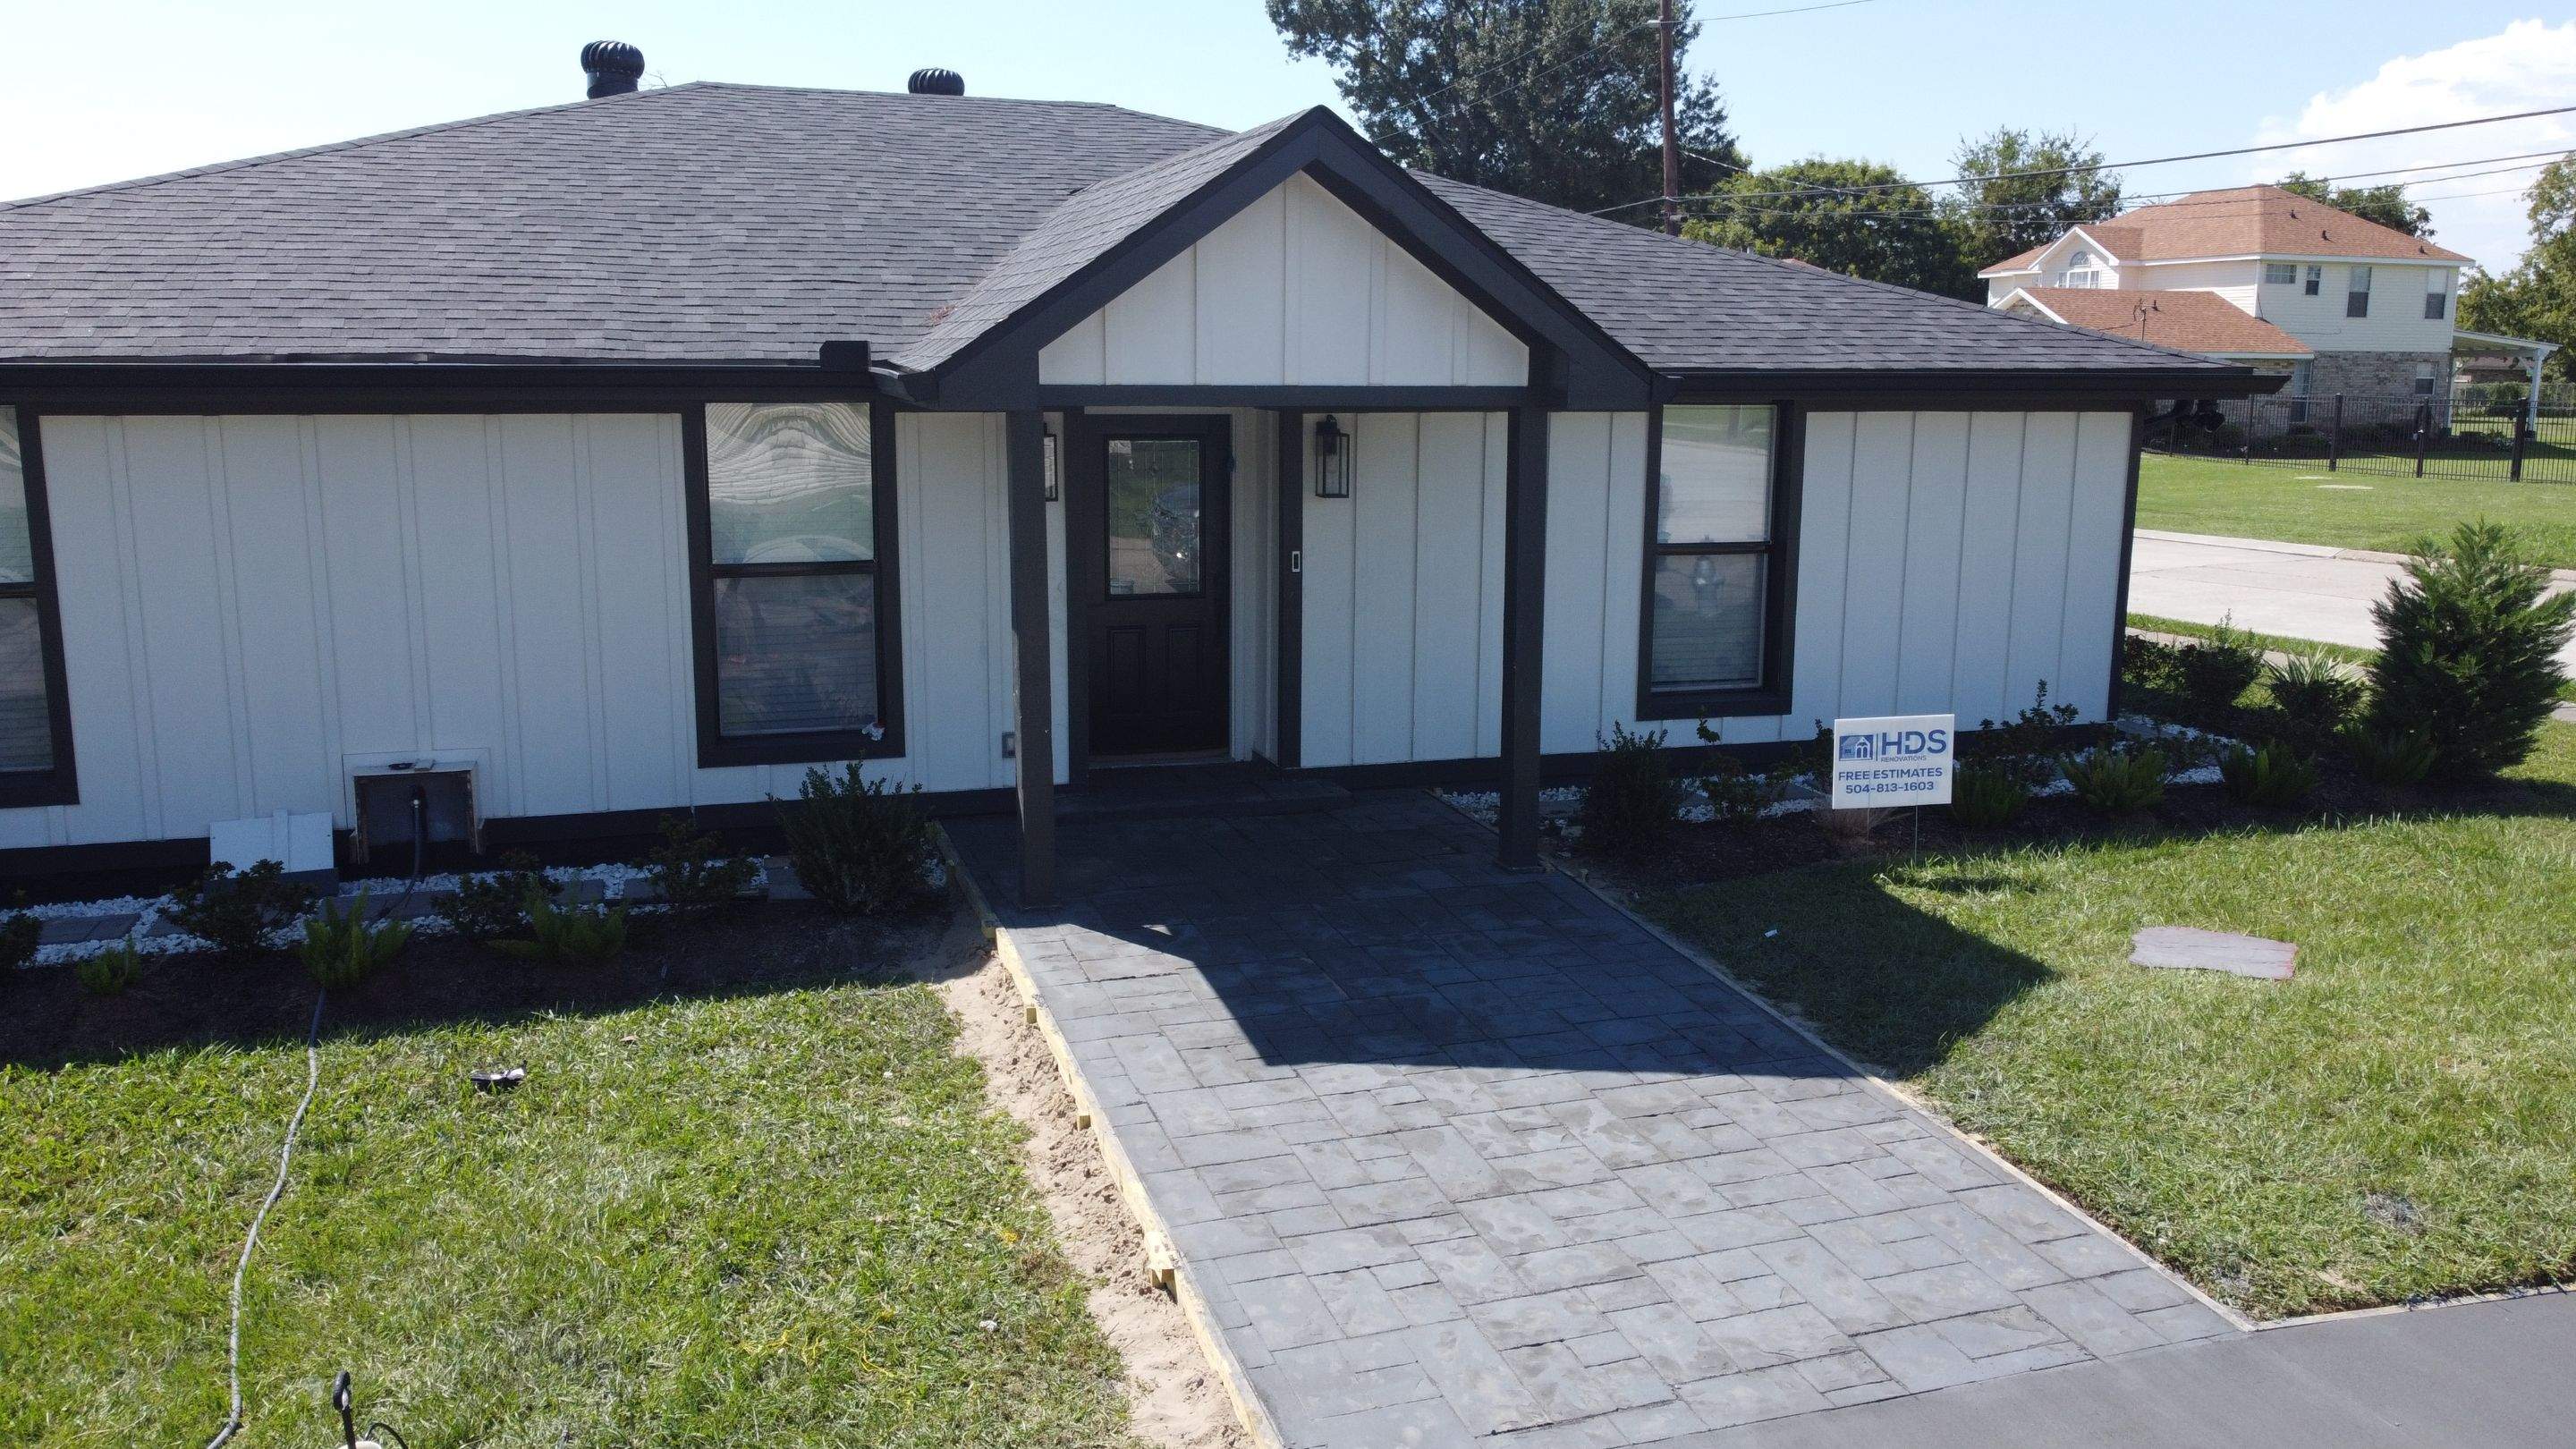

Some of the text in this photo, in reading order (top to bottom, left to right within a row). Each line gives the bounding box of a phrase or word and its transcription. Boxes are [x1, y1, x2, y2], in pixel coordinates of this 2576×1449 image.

[1881, 729, 1947, 755] HDS
[1881, 755, 1927, 763] RENOVATIONS
[1839, 767, 1943, 781] FREE ESTIMATES
[1846, 781, 1934, 794] 504-813-1603
